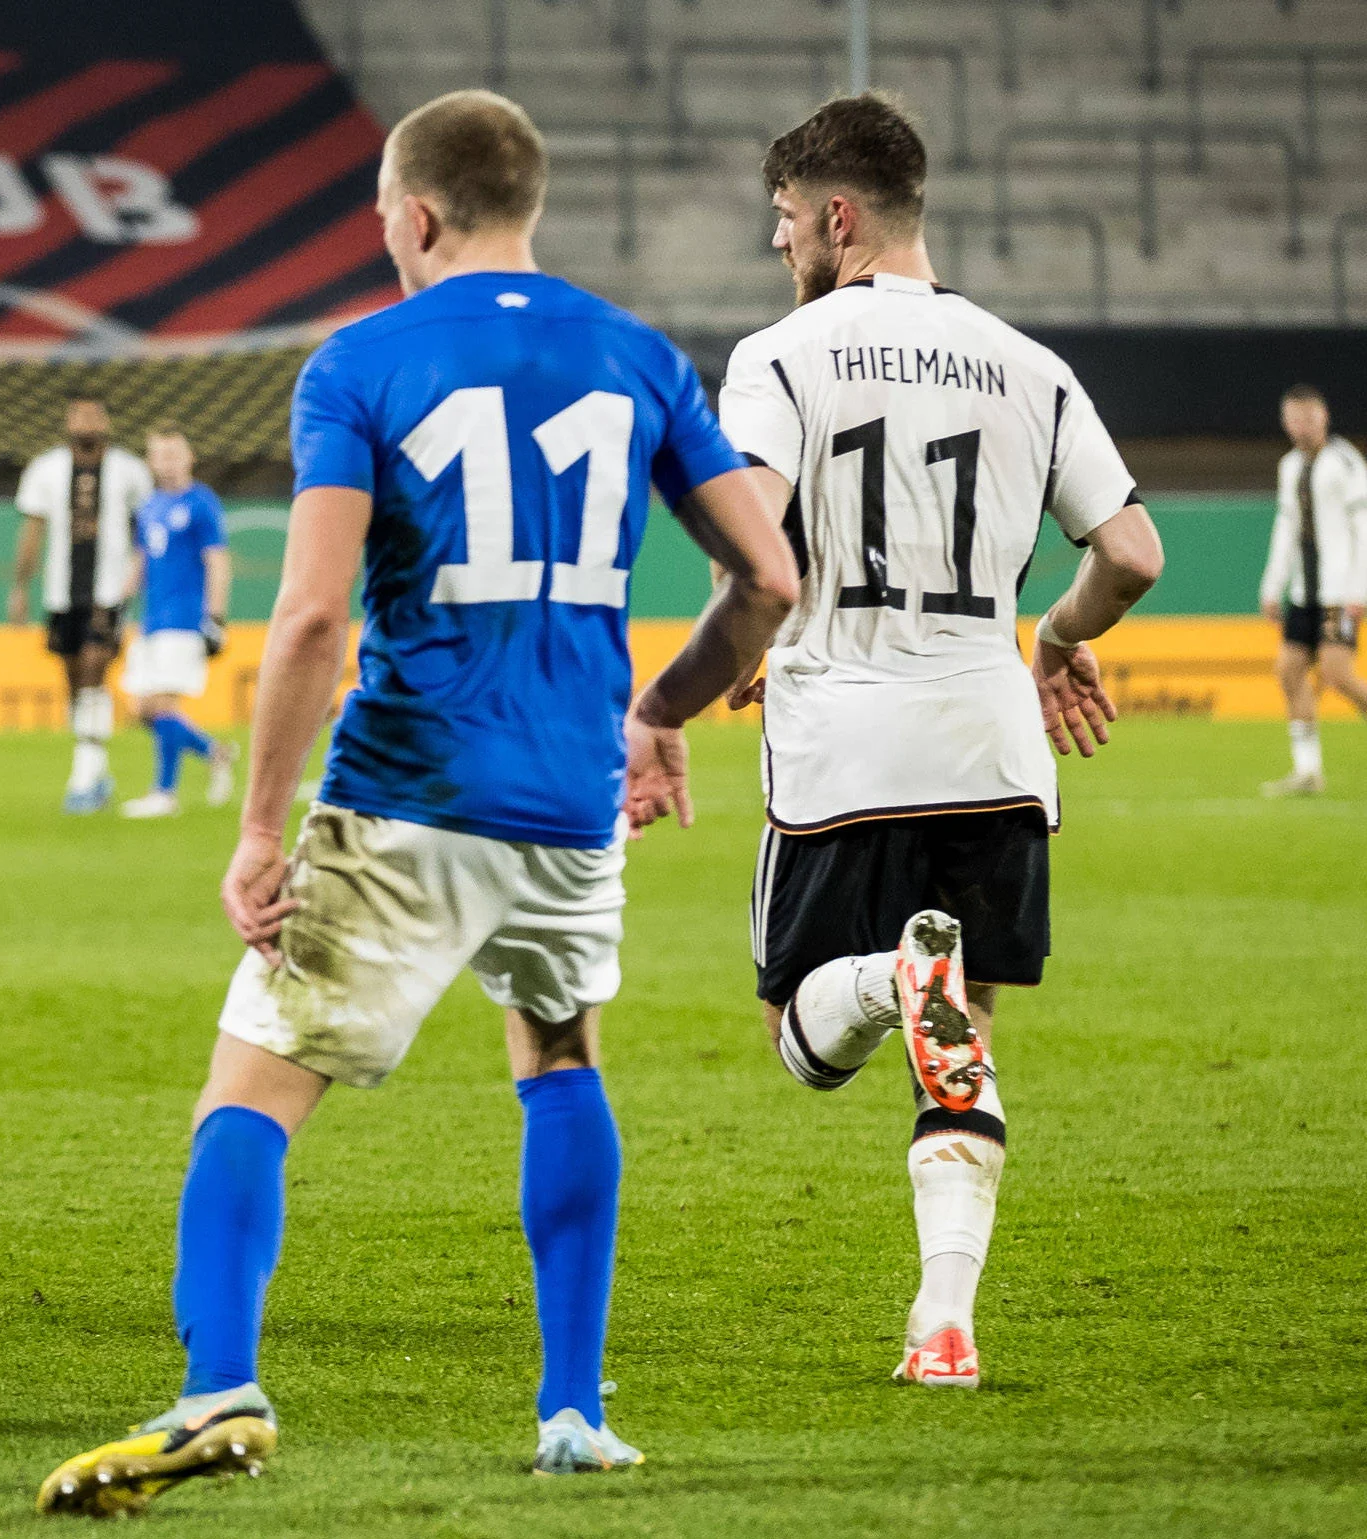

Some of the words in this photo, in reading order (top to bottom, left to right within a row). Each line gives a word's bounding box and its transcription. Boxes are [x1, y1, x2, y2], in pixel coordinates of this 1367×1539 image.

[829, 347, 1006, 397] THIELMANN
[398, 386, 634, 609] 11
[831, 416, 995, 619] 11
